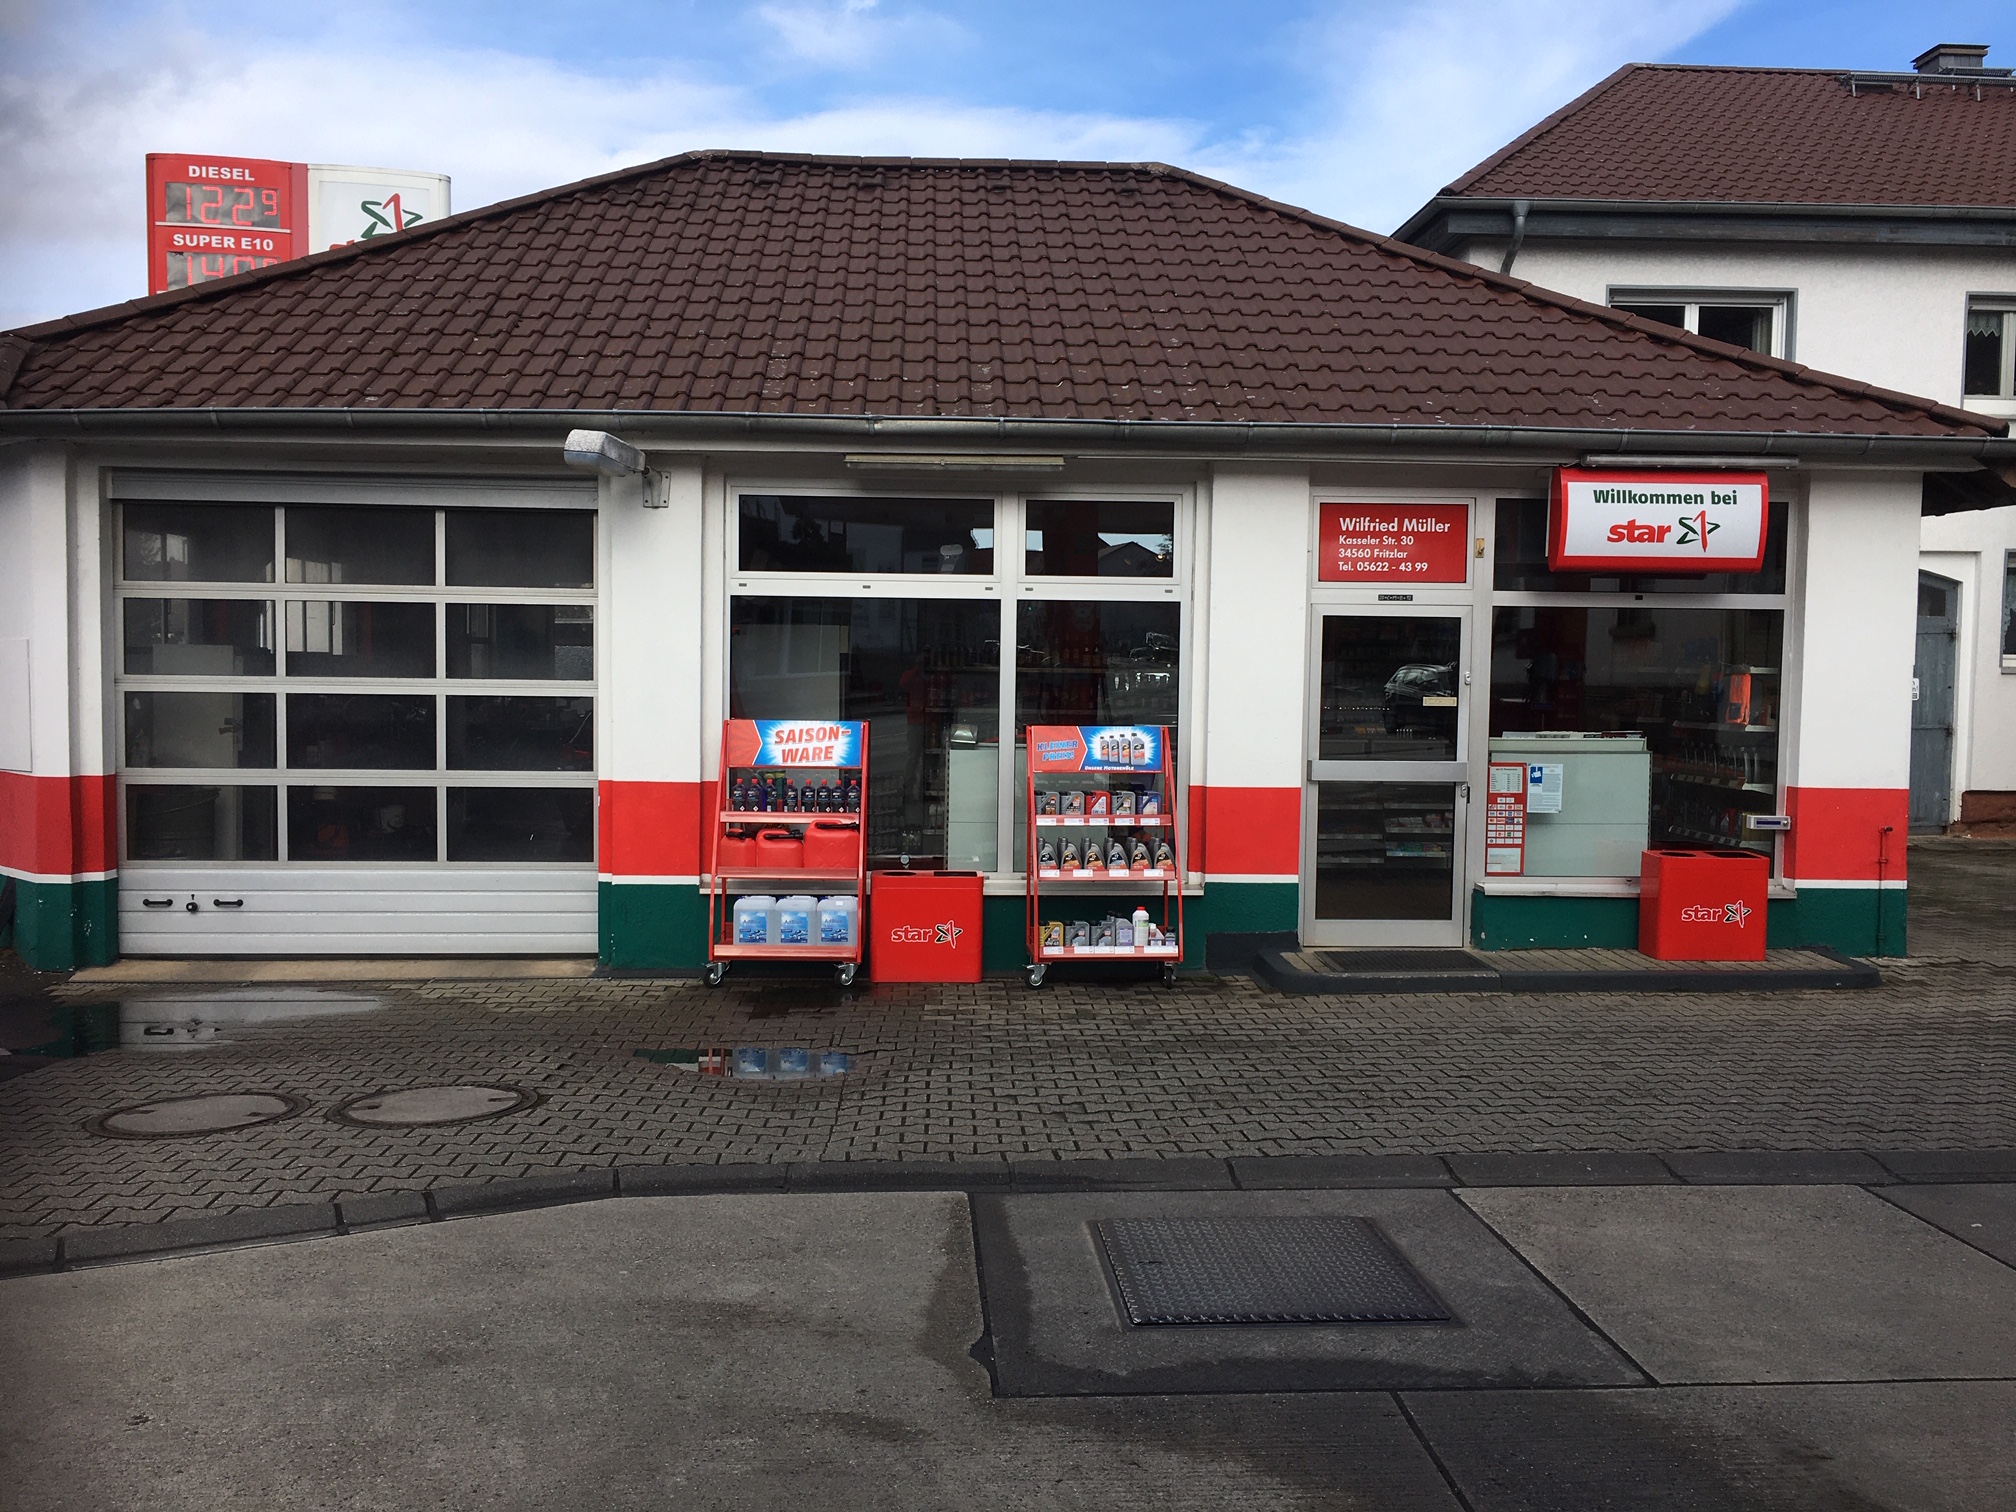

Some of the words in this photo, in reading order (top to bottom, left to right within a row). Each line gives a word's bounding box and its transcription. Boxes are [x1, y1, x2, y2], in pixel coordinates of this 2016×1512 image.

[188, 165, 255, 182] DIESEL
[173, 233, 235, 249] SUPER
[240, 237, 274, 252] E10
[1593, 488, 1704, 505] Willkommen
[1711, 489, 1737, 505] bei
[1339, 517, 1398, 532] Wilfried
[1402, 518, 1450, 533] Müller
[1607, 519, 1671, 543] star
[1339, 535, 1379, 545] Kasseler
[1382, 535, 1398, 545] Str.
[1400, 535, 1414, 546] 30
[1338, 548, 1371, 558] 34560
[1373, 549, 1408, 559] Fritzlar
[1338, 562, 1354, 571] Tel.
[1357, 562, 1389, 572] 05622
[1399, 562, 1412, 572] 43
[1415, 562, 1428, 572] 99
[774, 726, 851, 745] SAISON-
[1036, 740, 1078, 751] KLEINER
[781, 745, 834, 764] WARE
[1042, 750, 1074, 762] PREIS!
[1681, 905, 1722, 922] star
[891, 925, 932, 943] star
